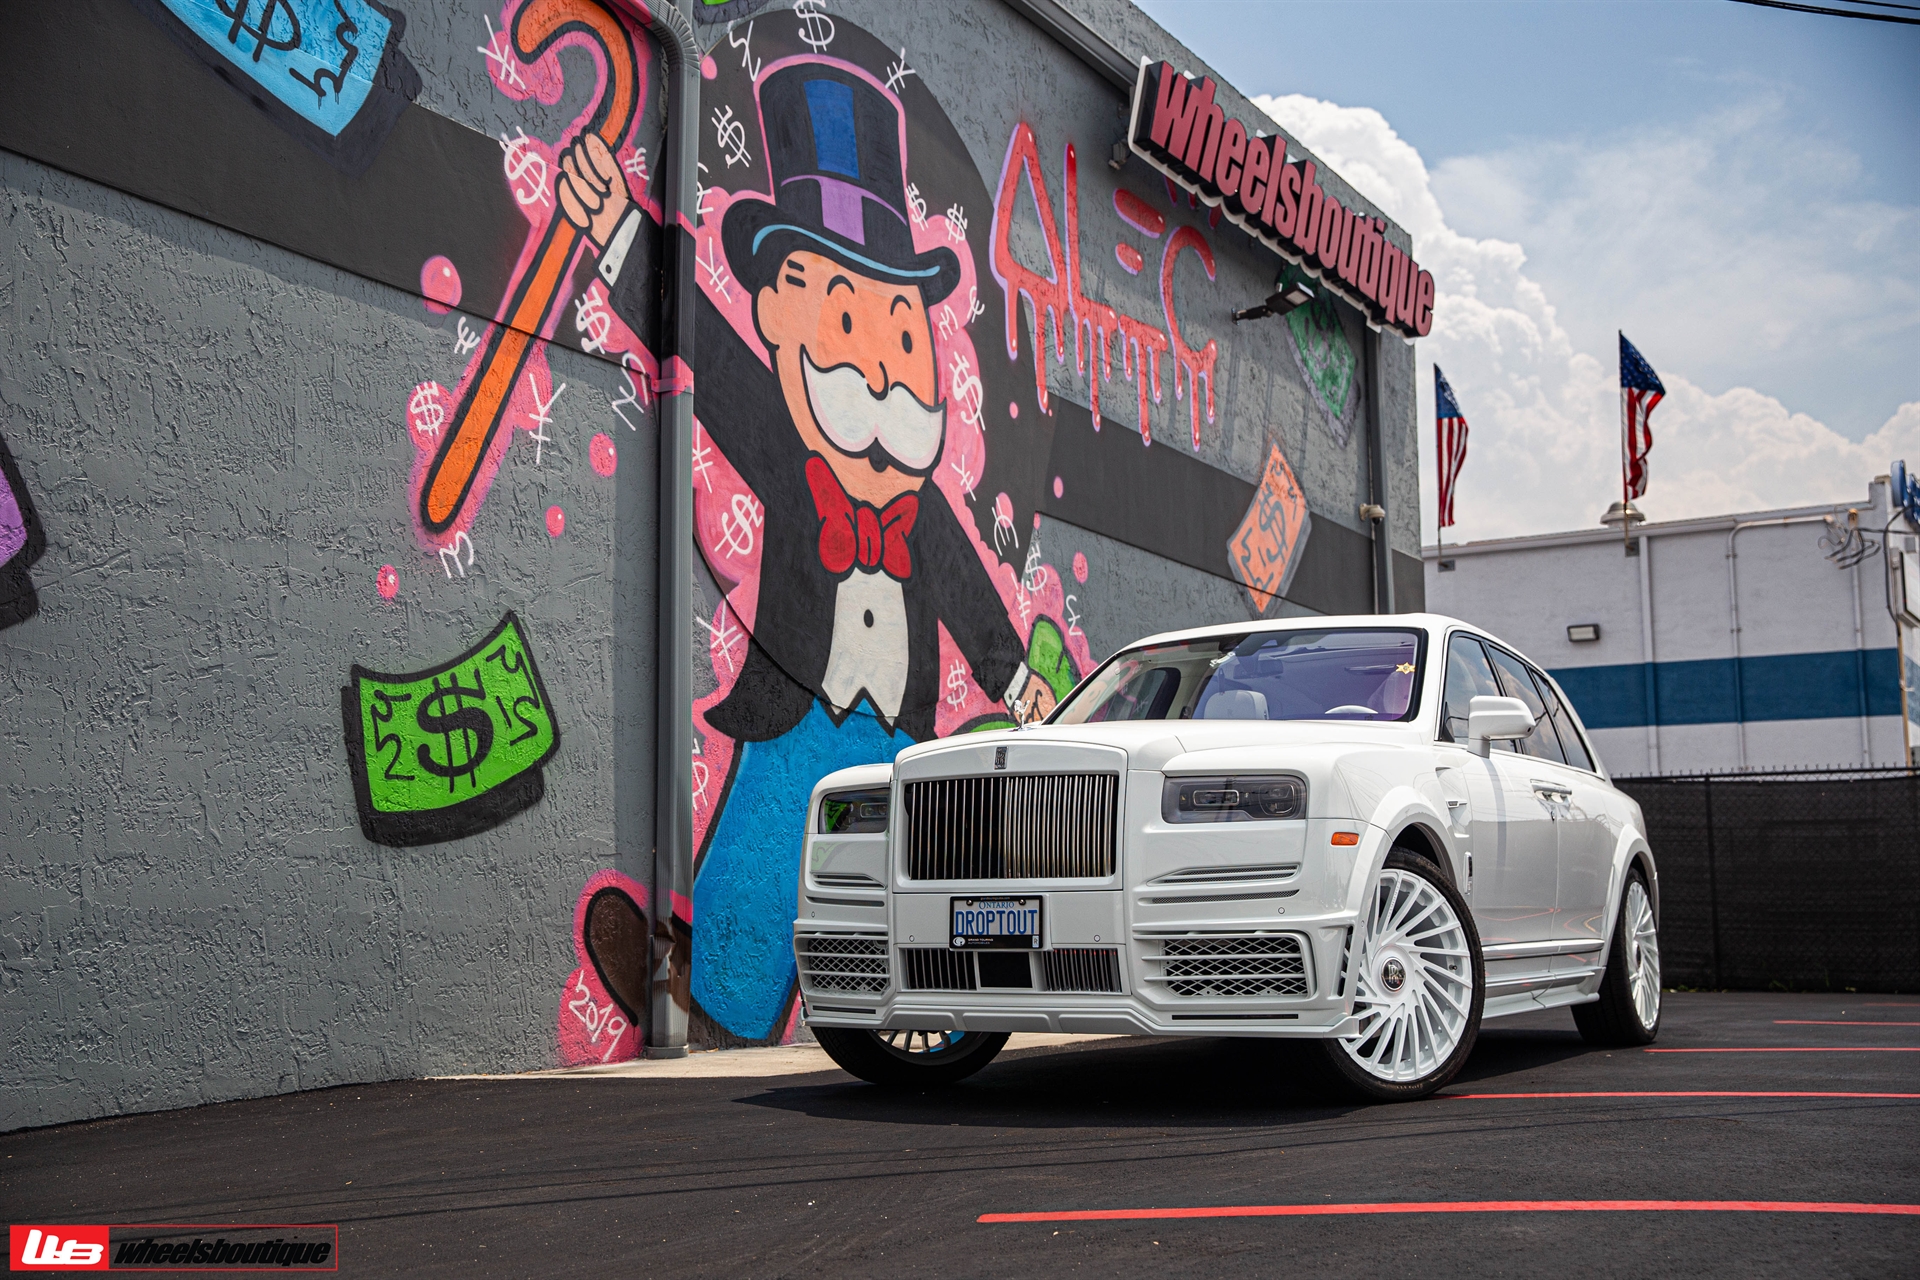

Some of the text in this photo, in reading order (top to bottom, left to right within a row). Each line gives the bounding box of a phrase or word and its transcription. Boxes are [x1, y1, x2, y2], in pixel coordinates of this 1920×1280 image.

[1147, 59, 1435, 337] wheelsboutique
[955, 909, 1038, 936] DROPTOUT
[568, 970, 627, 1062] 2019
